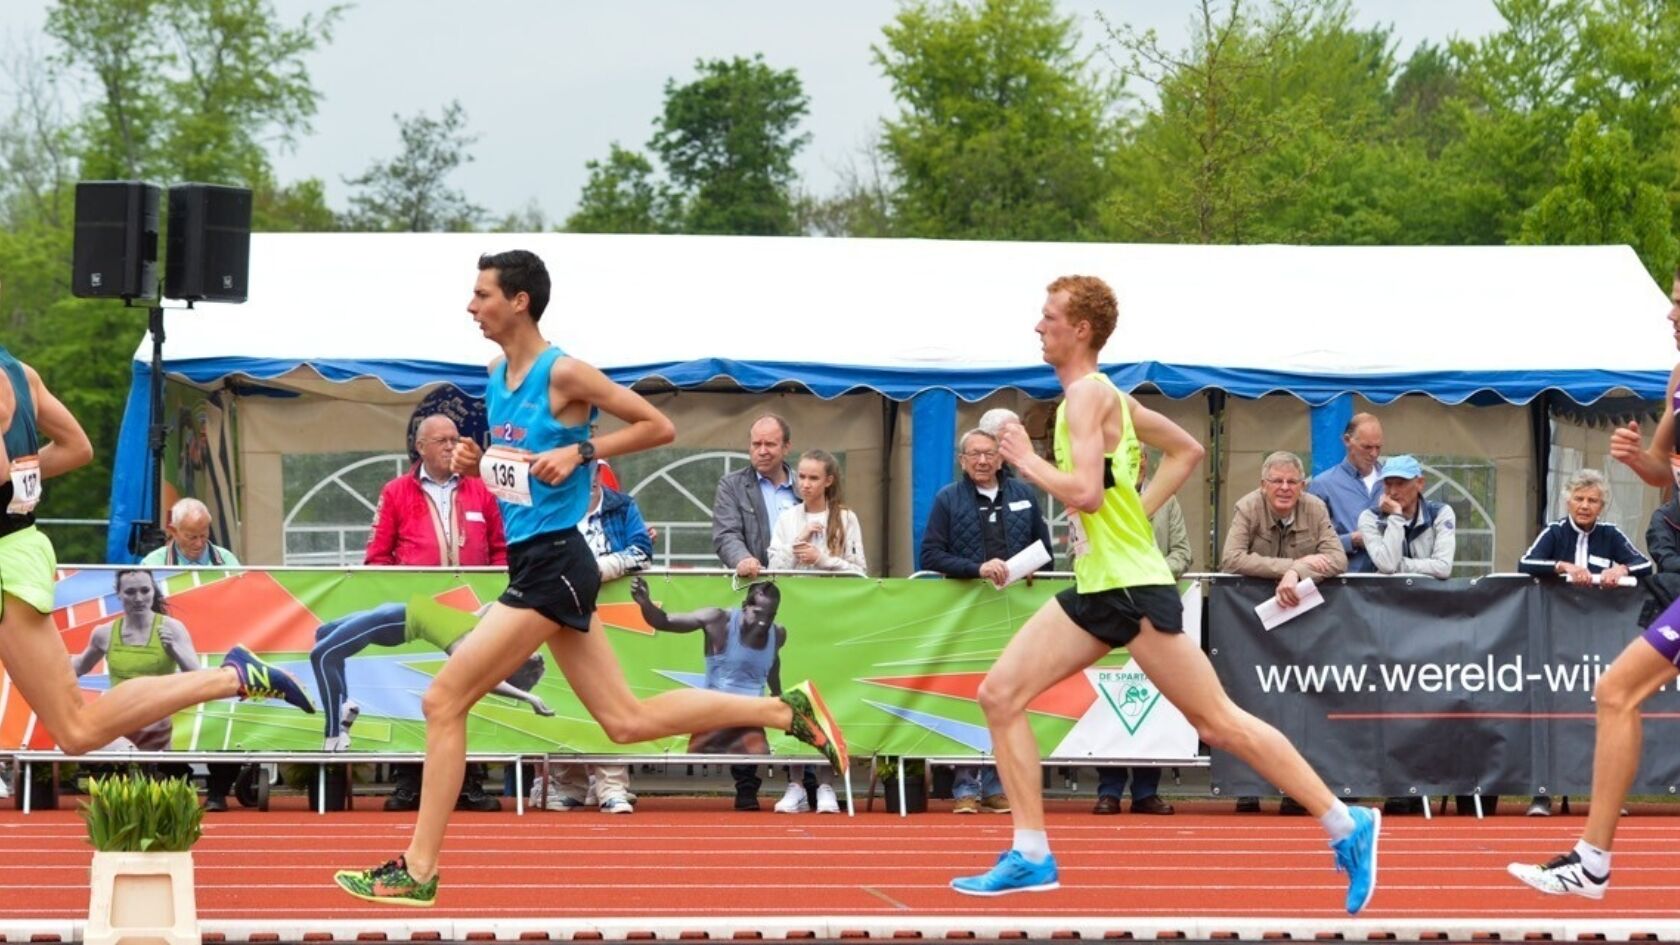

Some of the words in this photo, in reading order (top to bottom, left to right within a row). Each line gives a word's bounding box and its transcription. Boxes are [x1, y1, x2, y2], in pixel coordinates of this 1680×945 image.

[22, 473, 37, 498] 137
[492, 462, 515, 488] 136
[1098, 672, 1112, 681] DE
[1115, 672, 1148, 681] SPART
[1255, 654, 1610, 702] www.wereld-wij
